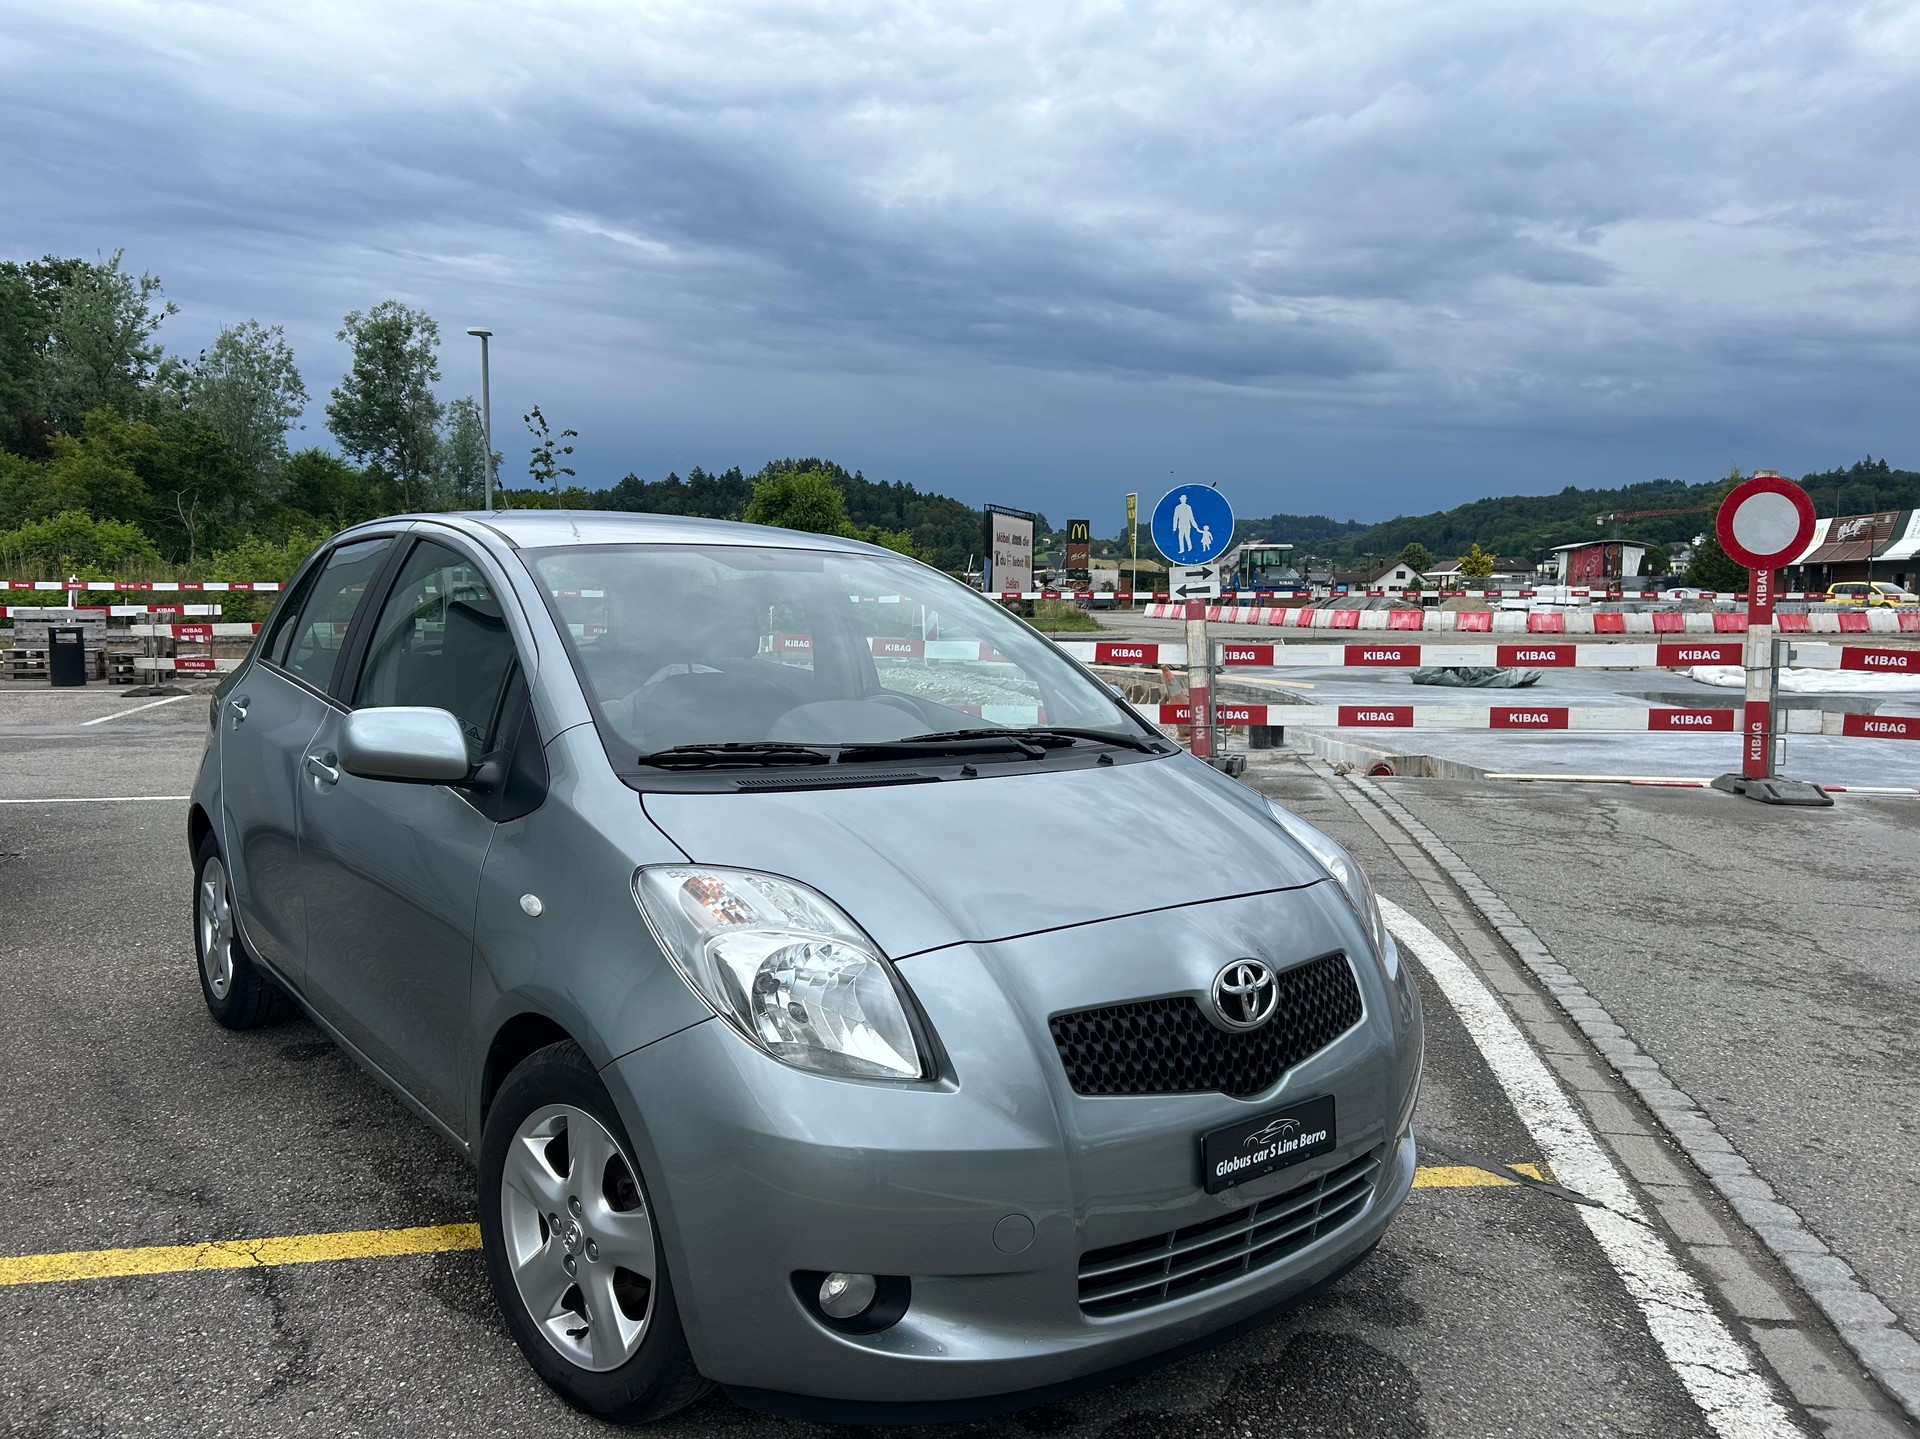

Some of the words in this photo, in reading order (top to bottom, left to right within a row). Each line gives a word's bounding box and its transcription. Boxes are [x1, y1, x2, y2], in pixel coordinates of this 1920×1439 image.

[1756, 569, 1768, 606] KIBAG
[784, 640, 810, 649] KIBAG
[885, 643, 912, 652] KIBAG
[1111, 648, 1143, 658] KIBAG
[1363, 650, 1401, 661] KIBAG
[1516, 650, 1556, 661] KIBAG
[1678, 650, 1721, 661] KIBAG
[1864, 655, 1908, 667] KIBAG
[1357, 711, 1395, 722] KIBAG
[1509, 713, 1549, 724] KIBAG
[1670, 714, 1713, 725] KIBAG
[1195, 705, 1206, 740] KIBAG
[1864, 721, 1907, 734] KIBAG
[1750, 721, 1763, 761] KIBAG
[1216, 1156, 1252, 1177] Globus
[1252, 1149, 1269, 1164] car
[1269, 1143, 1277, 1158] S
[1277, 1139, 1298, 1156] Line
[1299, 1129, 1327, 1148] Berro
